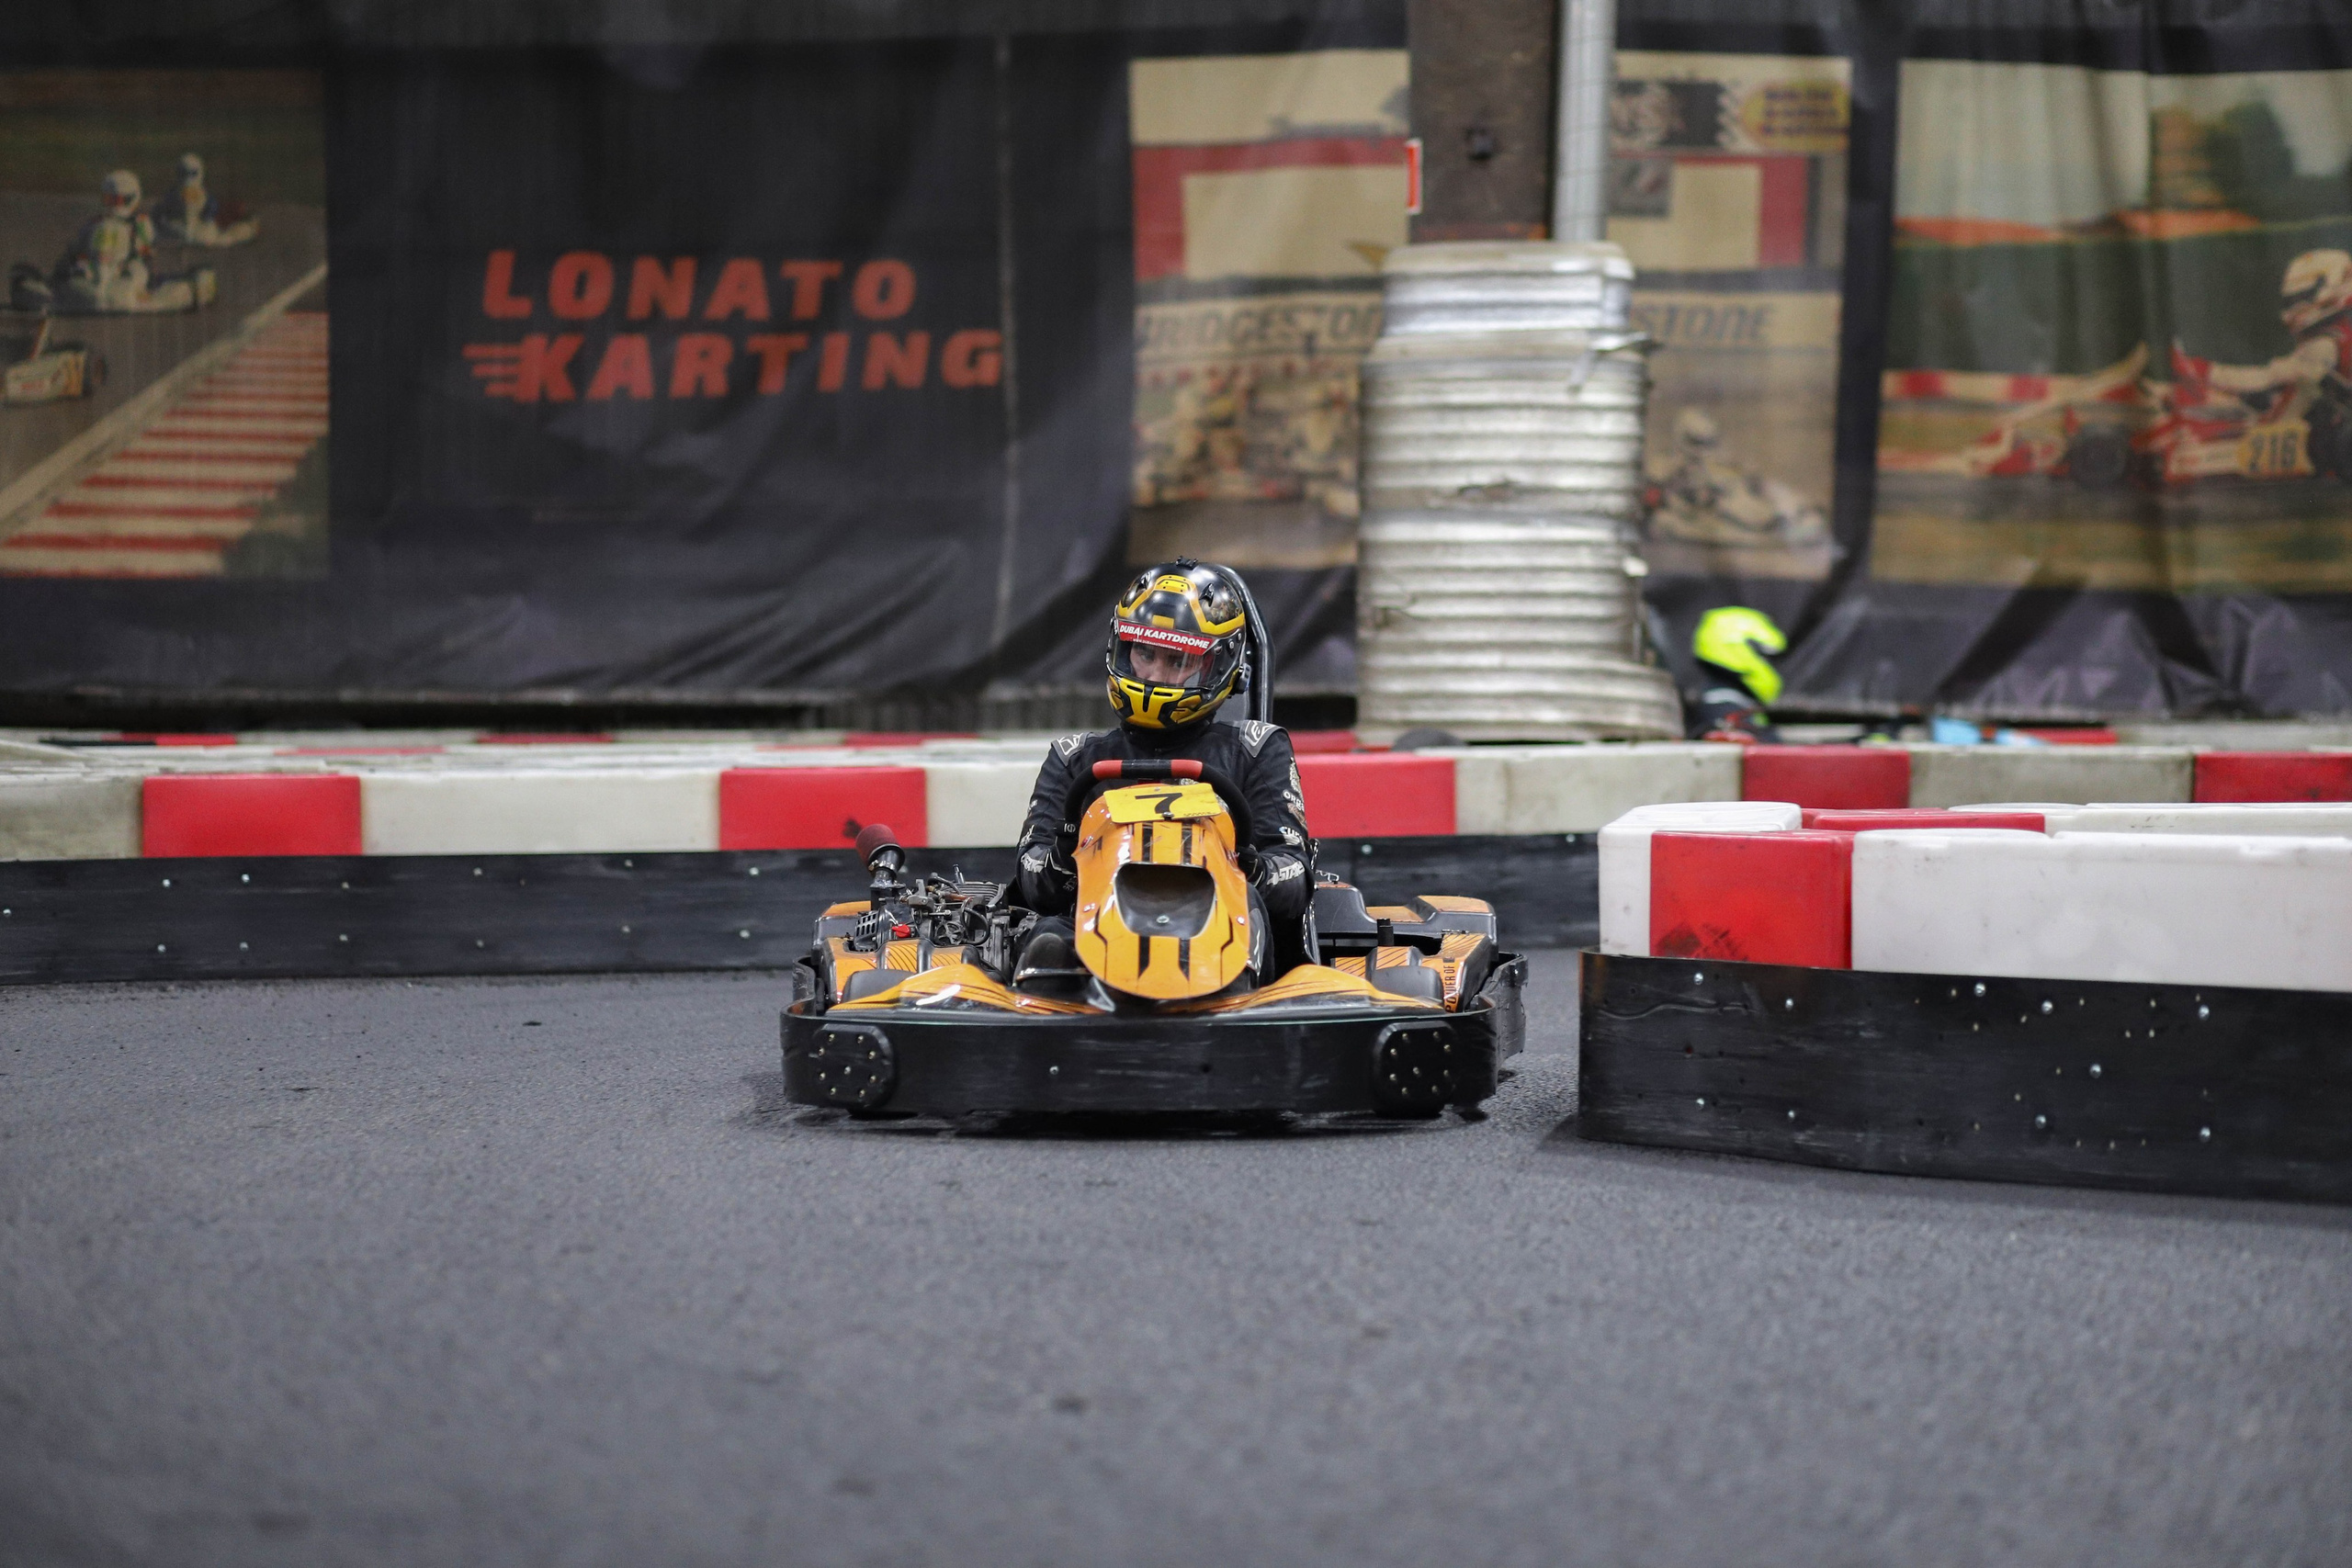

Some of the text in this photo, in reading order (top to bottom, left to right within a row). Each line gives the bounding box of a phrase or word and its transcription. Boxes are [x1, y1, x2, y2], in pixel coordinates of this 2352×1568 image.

[482, 250, 917, 321] LONATO
[512, 330, 1003, 402] KARTING
[1120, 625, 1210, 649] DUBAI KARTDROME
[1135, 792, 1183, 815] 7
[1443, 965, 1455, 974] OF
